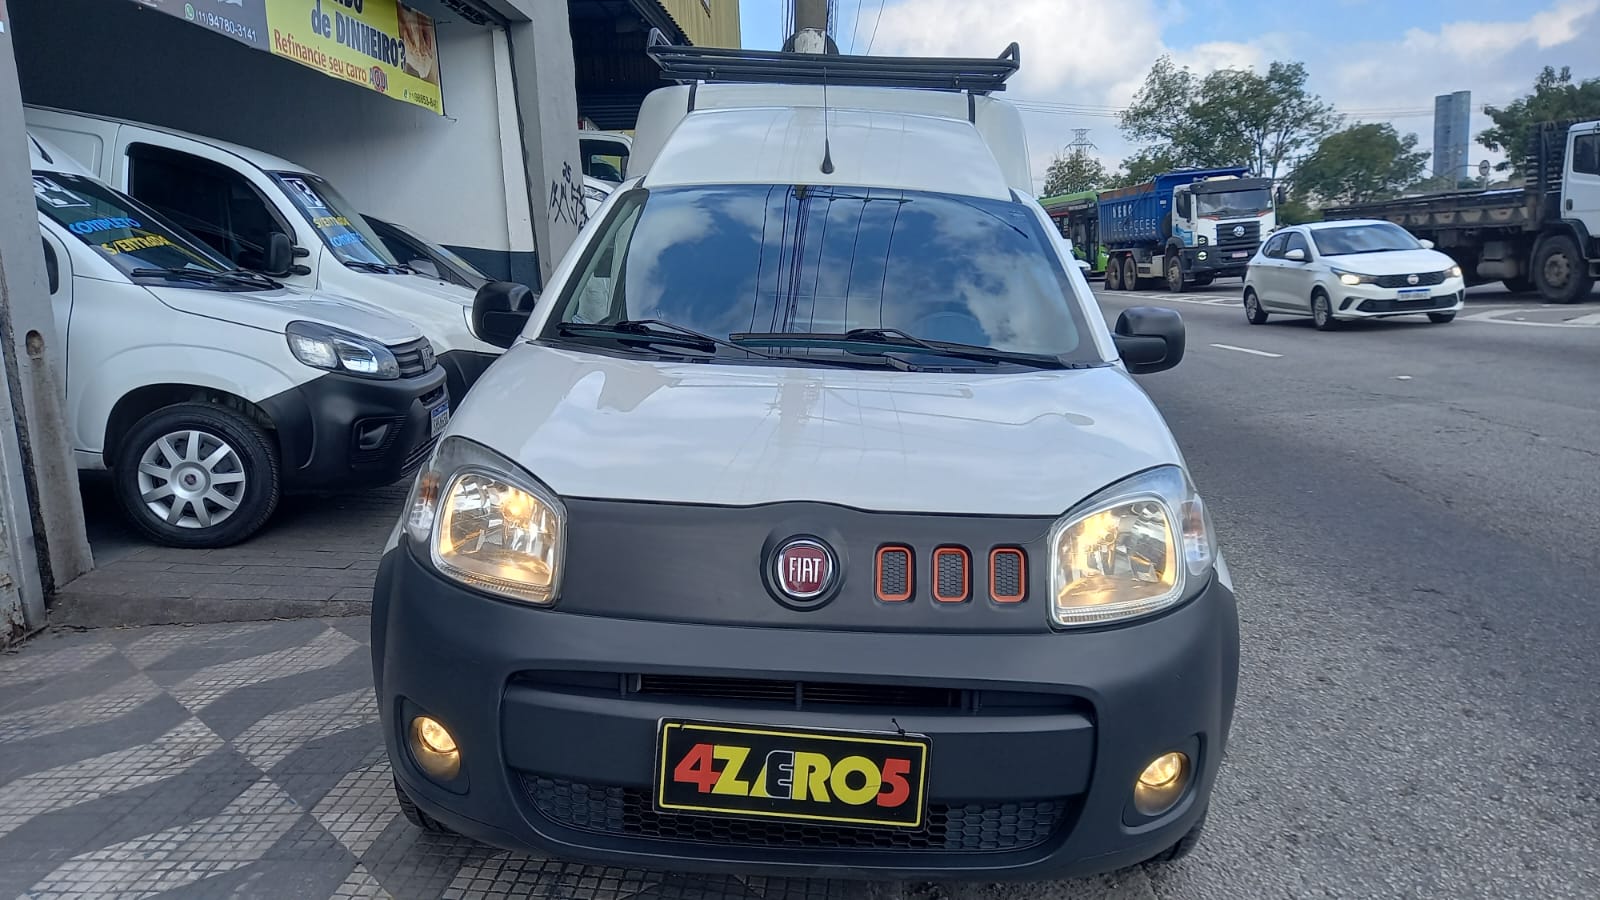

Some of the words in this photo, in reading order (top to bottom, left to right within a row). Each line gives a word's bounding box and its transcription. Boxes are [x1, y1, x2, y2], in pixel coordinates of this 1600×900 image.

[311, 0, 331, 39] de
[335, 11, 406, 70] DINHEIRO?
[274, 29, 327, 68] Refinancie
[329, 55, 344, 73] seu
[346, 62, 367, 82] carro
[369, 67, 389, 91] AQUI
[69, 217, 142, 235] COMPLETO
[101, 235, 172, 256] S/ENTRADA
[788, 556, 822, 583] FIAT
[673, 743, 911, 808] 4ZERO5
